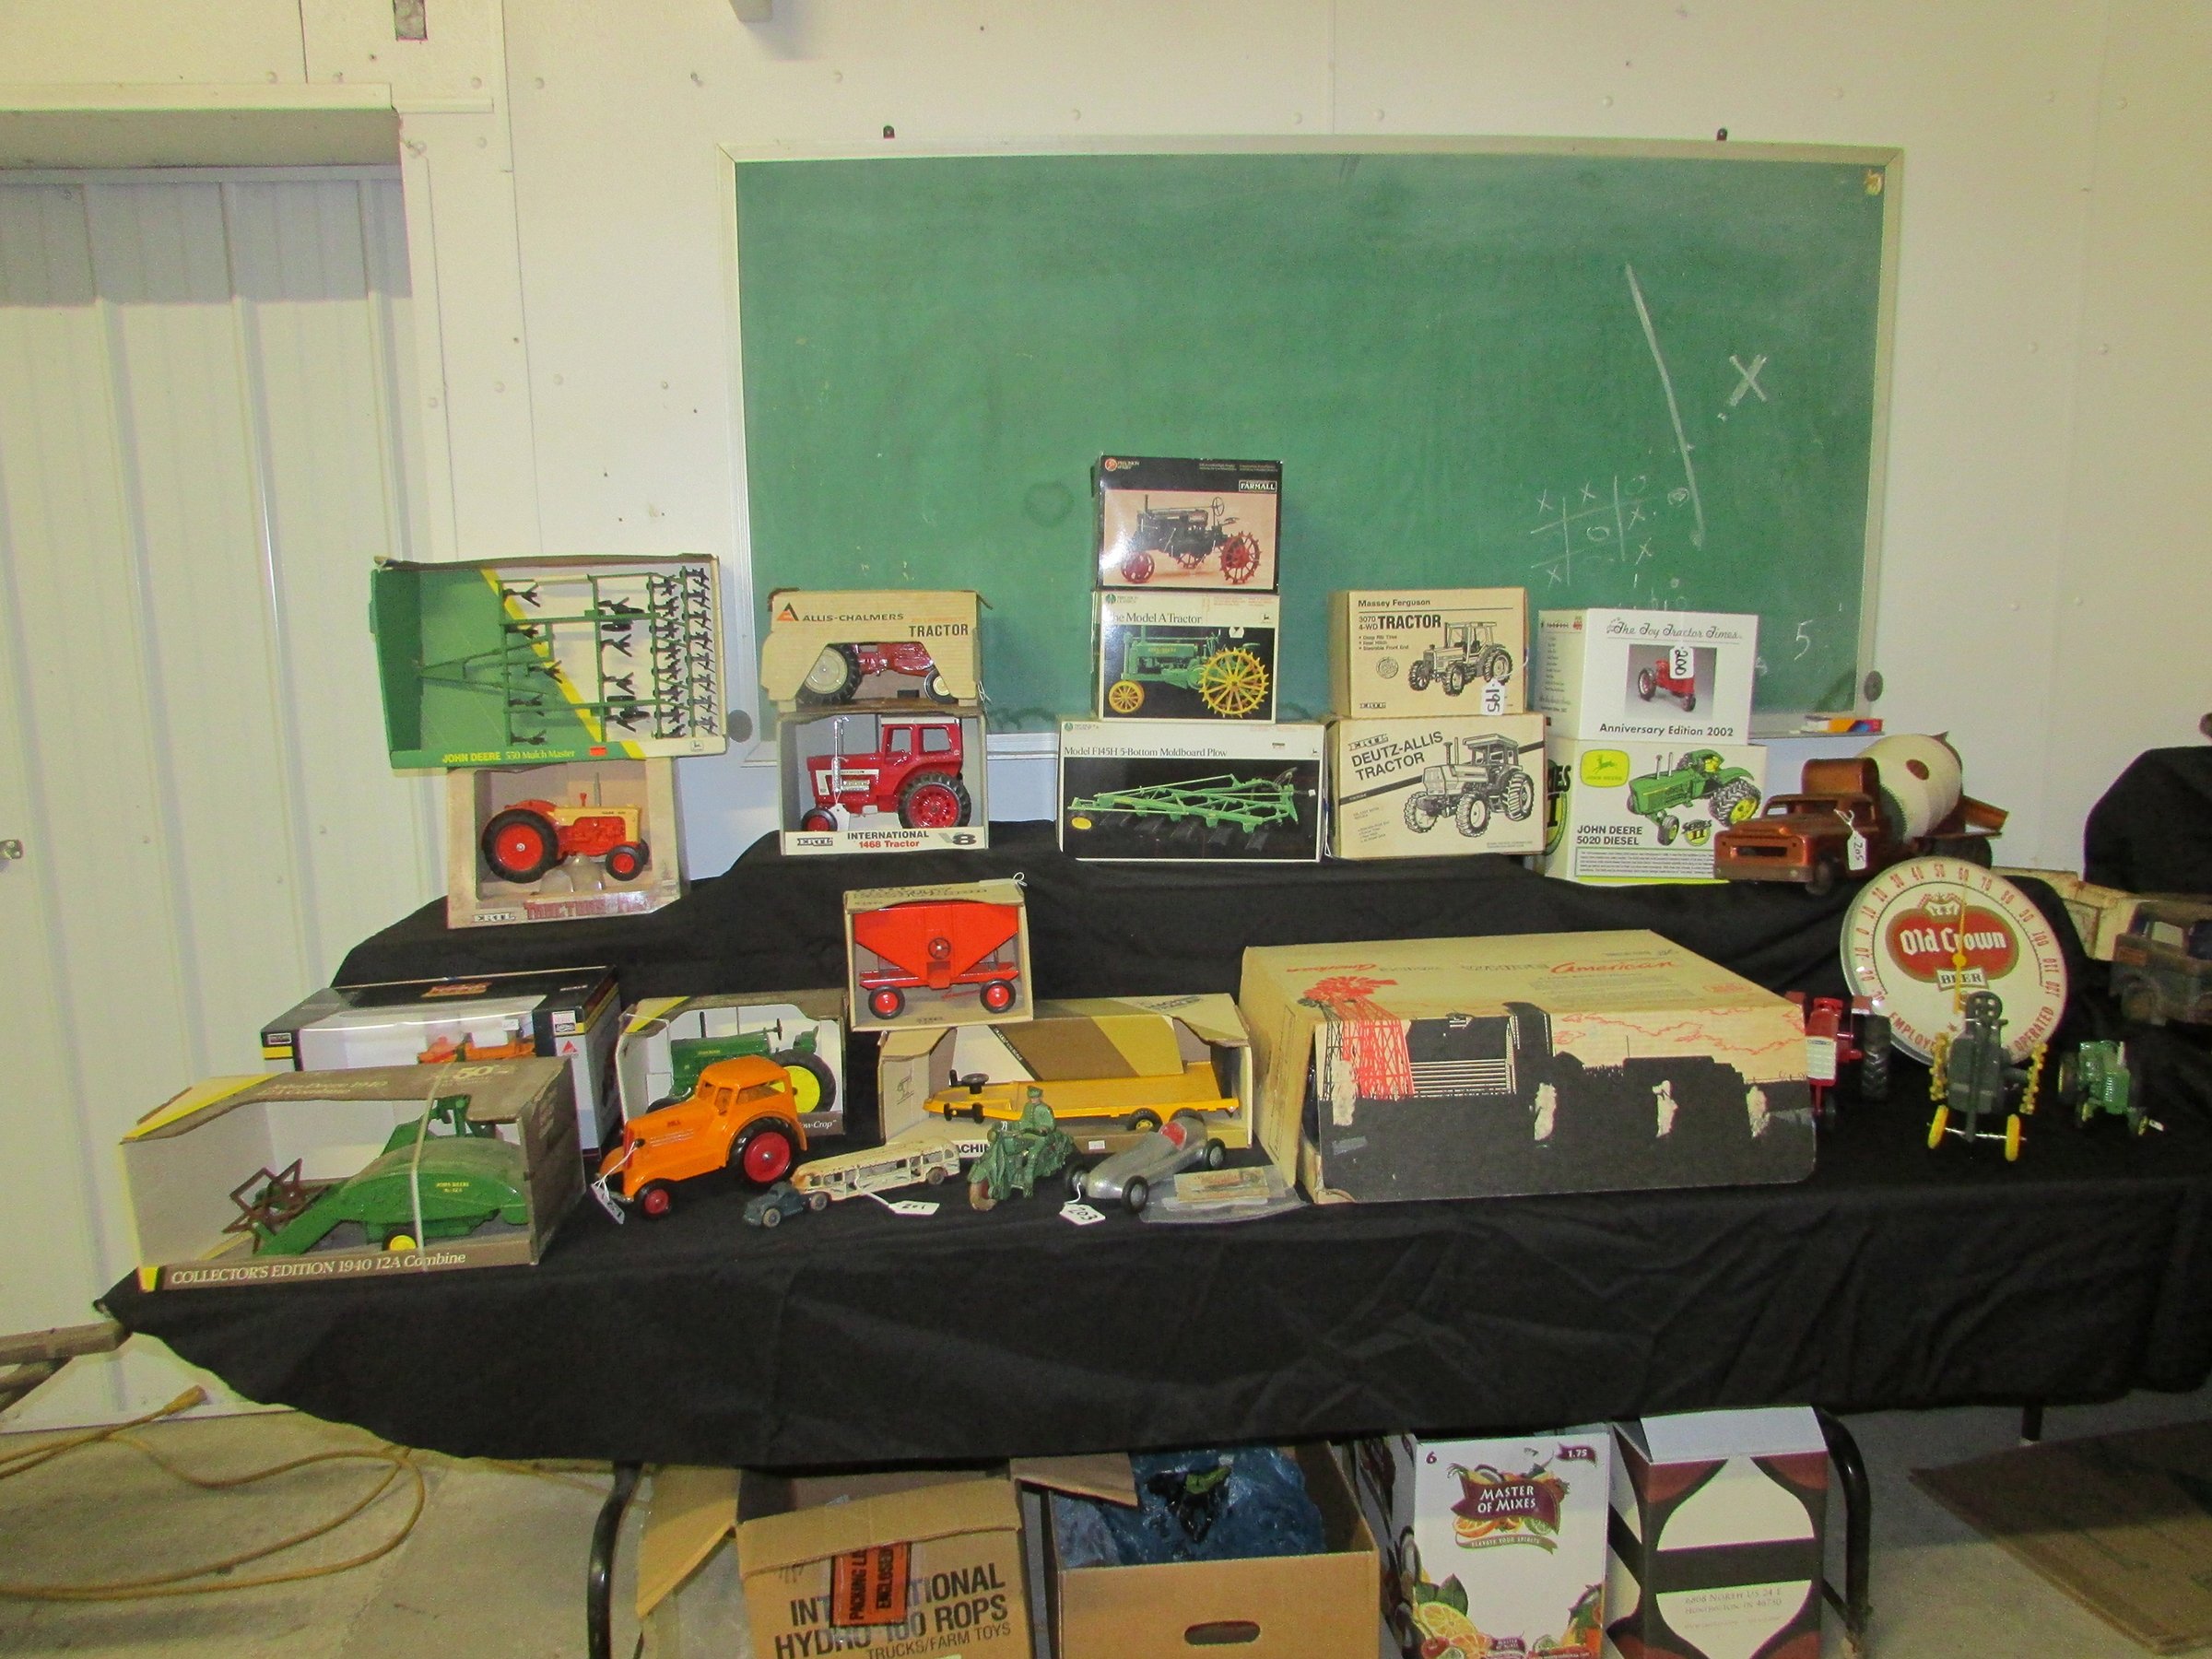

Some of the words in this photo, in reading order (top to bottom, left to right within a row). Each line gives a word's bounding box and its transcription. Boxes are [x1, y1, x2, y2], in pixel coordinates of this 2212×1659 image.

[1240, 482, 1277, 491] FARMALL
[1358, 600, 1390, 608] Massey
[1393, 599, 1430, 607] Ferguson
[802, 613, 904, 622] ALLIS-CHALMERS
[1126, 612, 1158, 624] Model
[1159, 613, 1167, 624] A
[1168, 612, 1203, 624] Tractor
[1378, 614, 1441, 630] TRACTOR
[909, 624, 969, 638] TRACTOR
[1614, 621, 1636, 635] The
[1663, 623, 1703, 638] Tractor
[1485, 688, 1500, 713] 195
[1599, 723, 1665, 736] Anniversary
[1668, 724, 1703, 736] Edition
[1707, 726, 1734, 736] 2002
[442, 752, 469, 764] JOHN
[470, 751, 501, 762] DEERE
[522, 749, 547, 760] Mulch
[548, 748, 576, 759] Master
[1064, 747, 1090, 757] Model
[1091, 747, 1119, 757] F145H
[1119, 747, 1159, 757] 5-Bottom
[1159, 747, 1206, 758] Moldboard
[1206, 748, 1228, 758] Plow
[1351, 731, 1443, 767] DEUTZ-ALLIS
[1355, 752, 1425, 782] TRACTOR
[1577, 825, 1606, 834] JOHN
[1608, 826, 1642, 835] DEERE
[1682, 819, 1712, 832] SERIES
[797, 837, 833, 846] ERTL
[847, 831, 929, 841] INTERNATIONAL
[1577, 836, 1602, 845] 5020
[1604, 837, 1639, 846] DIESEL
[859, 841, 881, 849] 1468
[883, 840, 920, 849] Tractor
[1900, 927, 1940, 956] Old
[1940, 927, 2006, 953] Crown
[1550, 960, 1673, 974] American
[1888, 1011, 1936, 1050] EMPLOY
[2014, 1006, 2054, 1052] OPERATED
[1068, 1206, 1099, 1220] 203
[171, 1262, 269, 1285] COLLECTOR'S
[272, 1261, 335, 1278] EDITION
[337, 1258, 372, 1272] 1940
[376, 1256, 402, 1270] 12A
[404, 1252, 466, 1268] Combine
[1426, 1451, 1438, 1465] 6
[1567, 1449, 1588, 1458] 1.75
[1479, 1485, 1535, 1501] MASTER
[1477, 1502, 1494, 1513] OF
[1496, 1498, 1536, 1512] MIXES
[790, 1563, 1006, 1627] INTTIONAL
[849, 1569, 867, 1620] PACKING
[935, 1594, 1008, 1632] ROPS
[868, 1631, 971, 1659] TRUCKS/FARM
[973, 1621, 1012, 1641] TOYS
